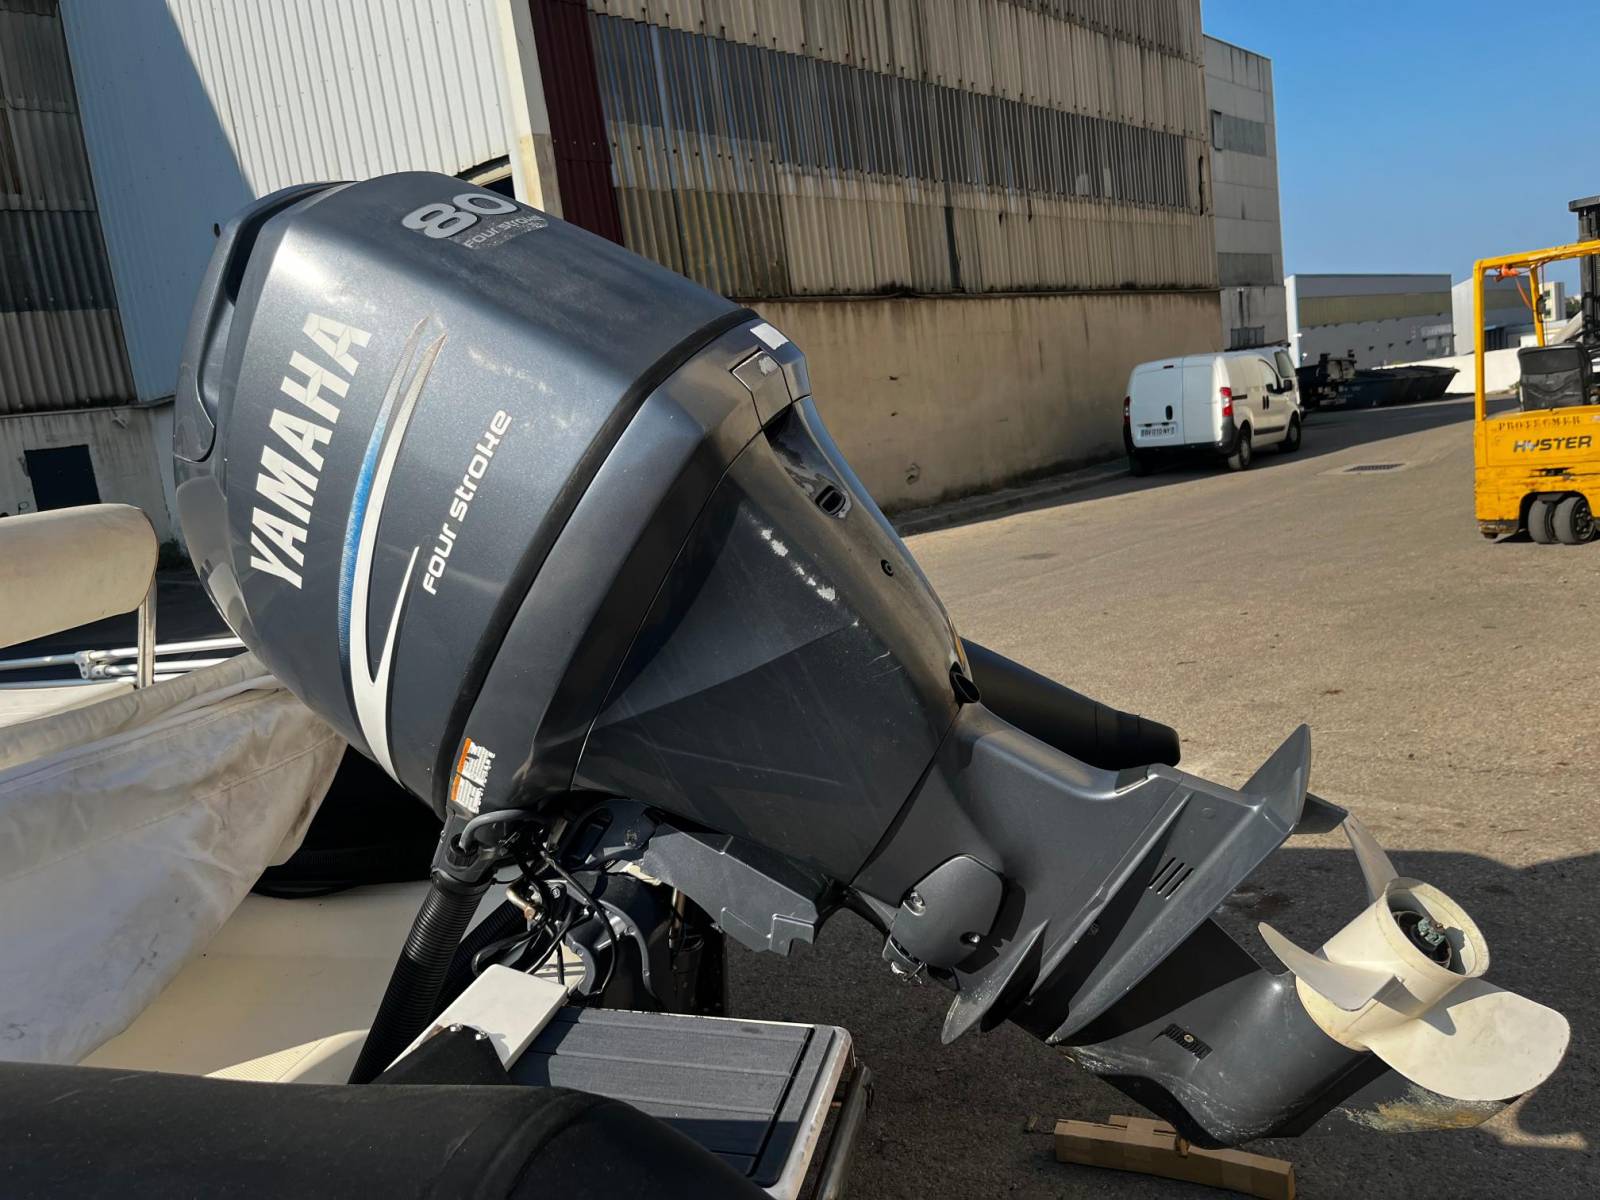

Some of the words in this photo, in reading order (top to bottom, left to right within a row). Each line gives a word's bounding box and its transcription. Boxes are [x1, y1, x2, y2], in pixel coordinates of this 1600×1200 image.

[402, 193, 518, 239] 80
[250, 312, 372, 590] YAMAHA
[1513, 435, 1593, 453] HYSTER
